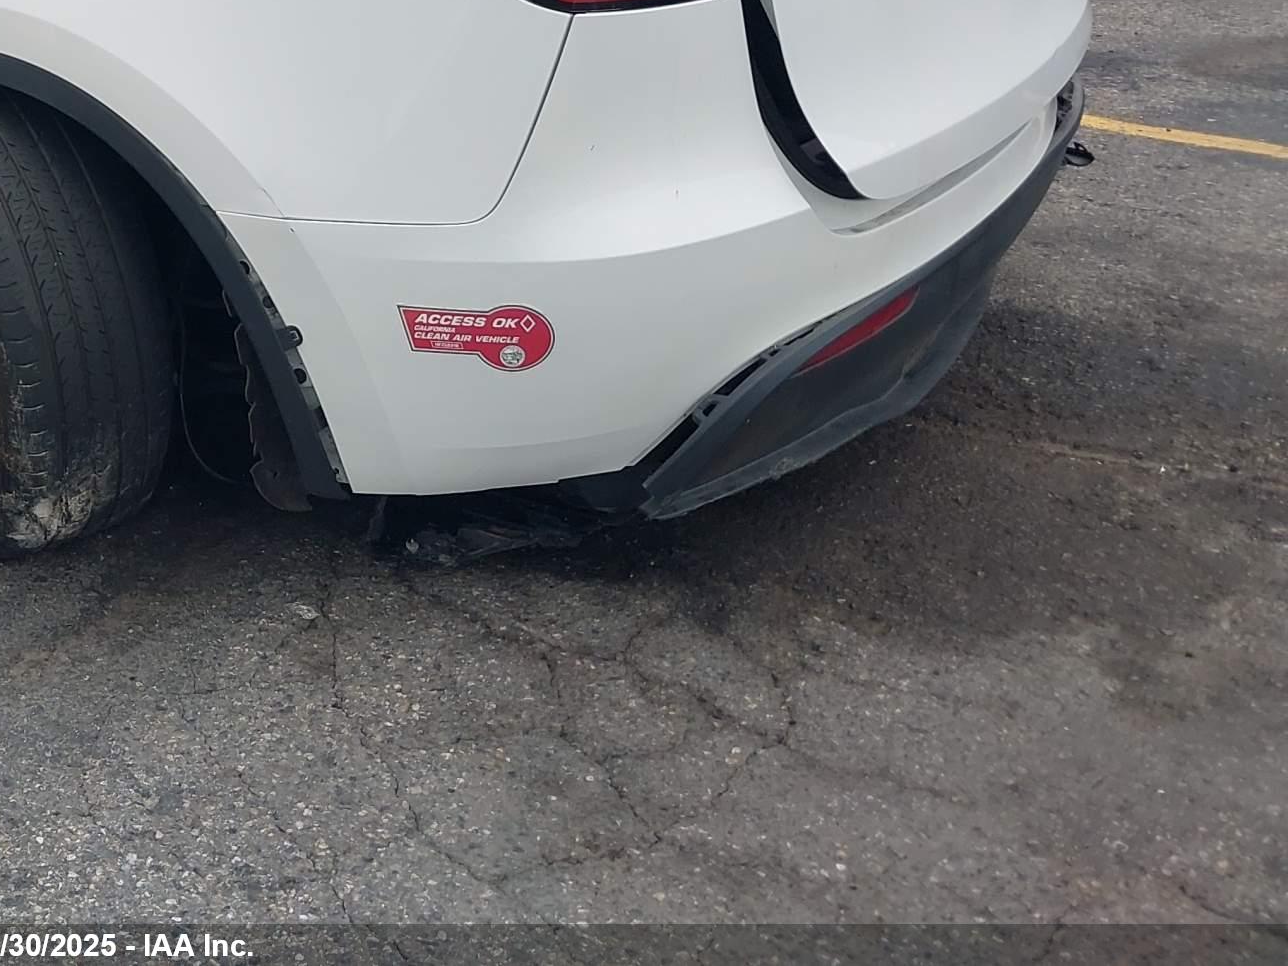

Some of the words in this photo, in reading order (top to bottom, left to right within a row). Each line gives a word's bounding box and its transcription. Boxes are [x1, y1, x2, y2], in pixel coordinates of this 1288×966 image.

[414, 313, 487, 327] ACCESS
[492, 318, 519, 328] OK
[414, 324, 455, 333] CALIFORNIA
[414, 332, 451, 341] CLEAN
[452, 334, 472, 342] AIR
[475, 336, 520, 344] VEHICLE
